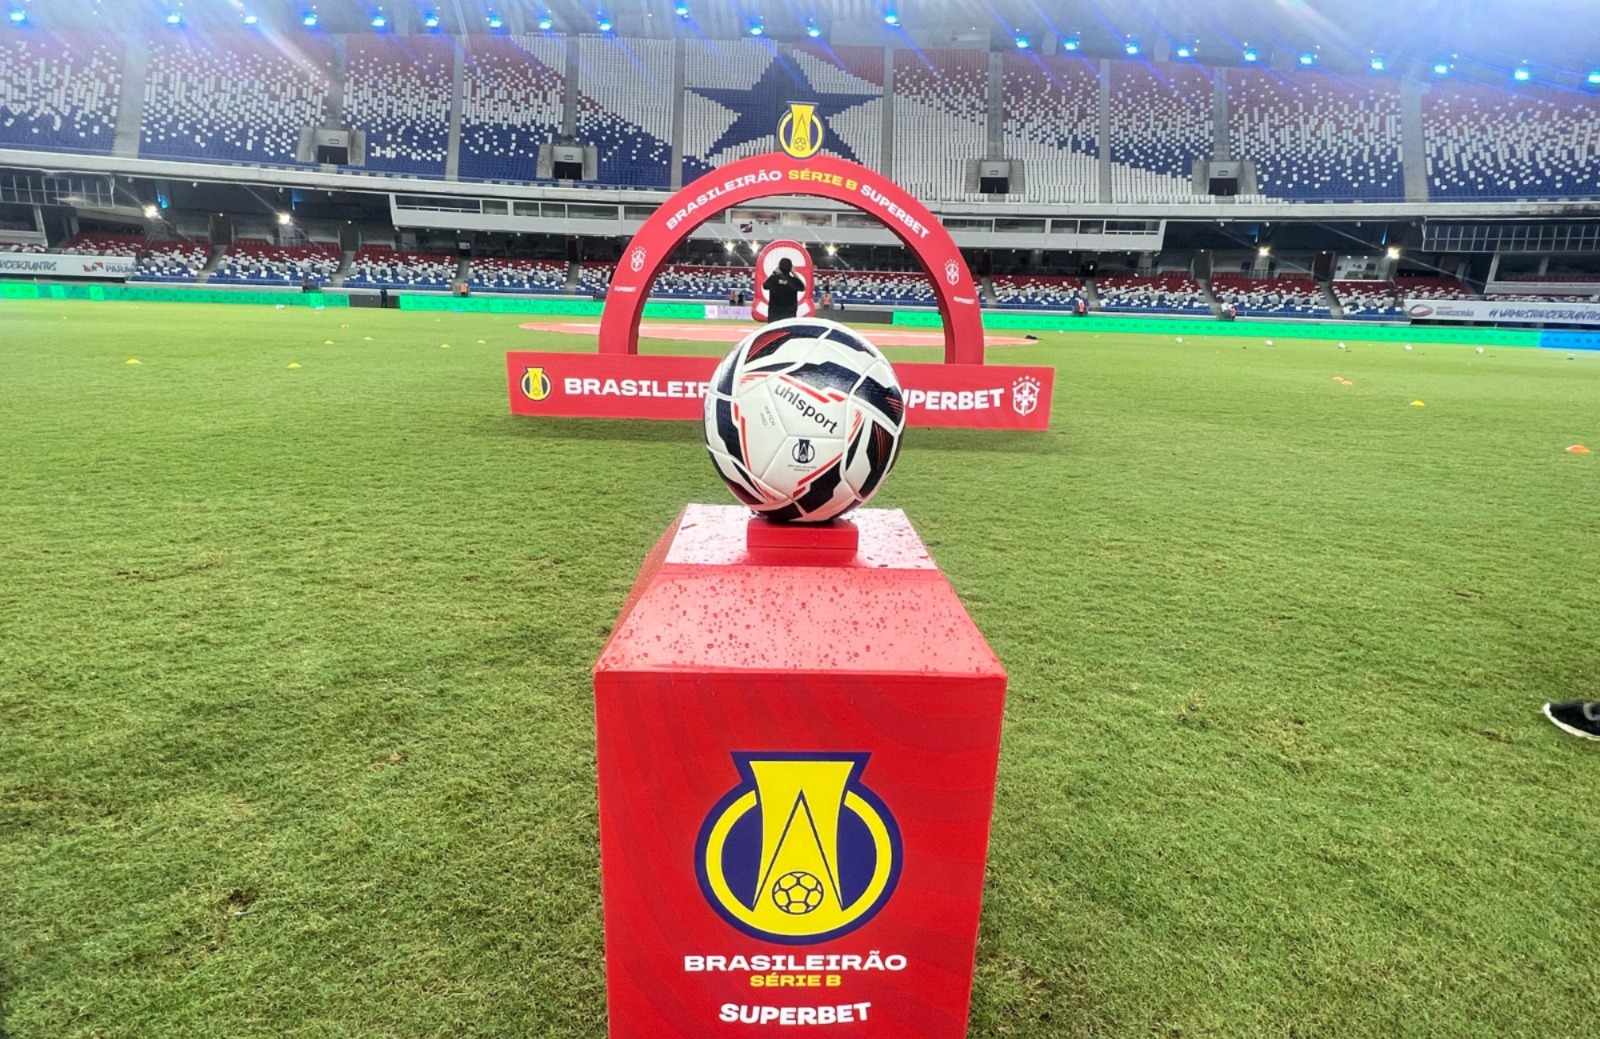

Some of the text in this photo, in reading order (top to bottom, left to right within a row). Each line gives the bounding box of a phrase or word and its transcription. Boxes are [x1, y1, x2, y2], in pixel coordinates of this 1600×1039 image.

[665, 168, 930, 239] BRASILEIRÃO SÉRIE B SUPERBET
[564, 377, 710, 398] BRASILEIR
[774, 384, 838, 434] uhlsport
[683, 950, 908, 972] BRASILEIRÃO
[749, 972, 842, 988] SÉRIE B
[718, 1002, 872, 1026] SUPERBET
